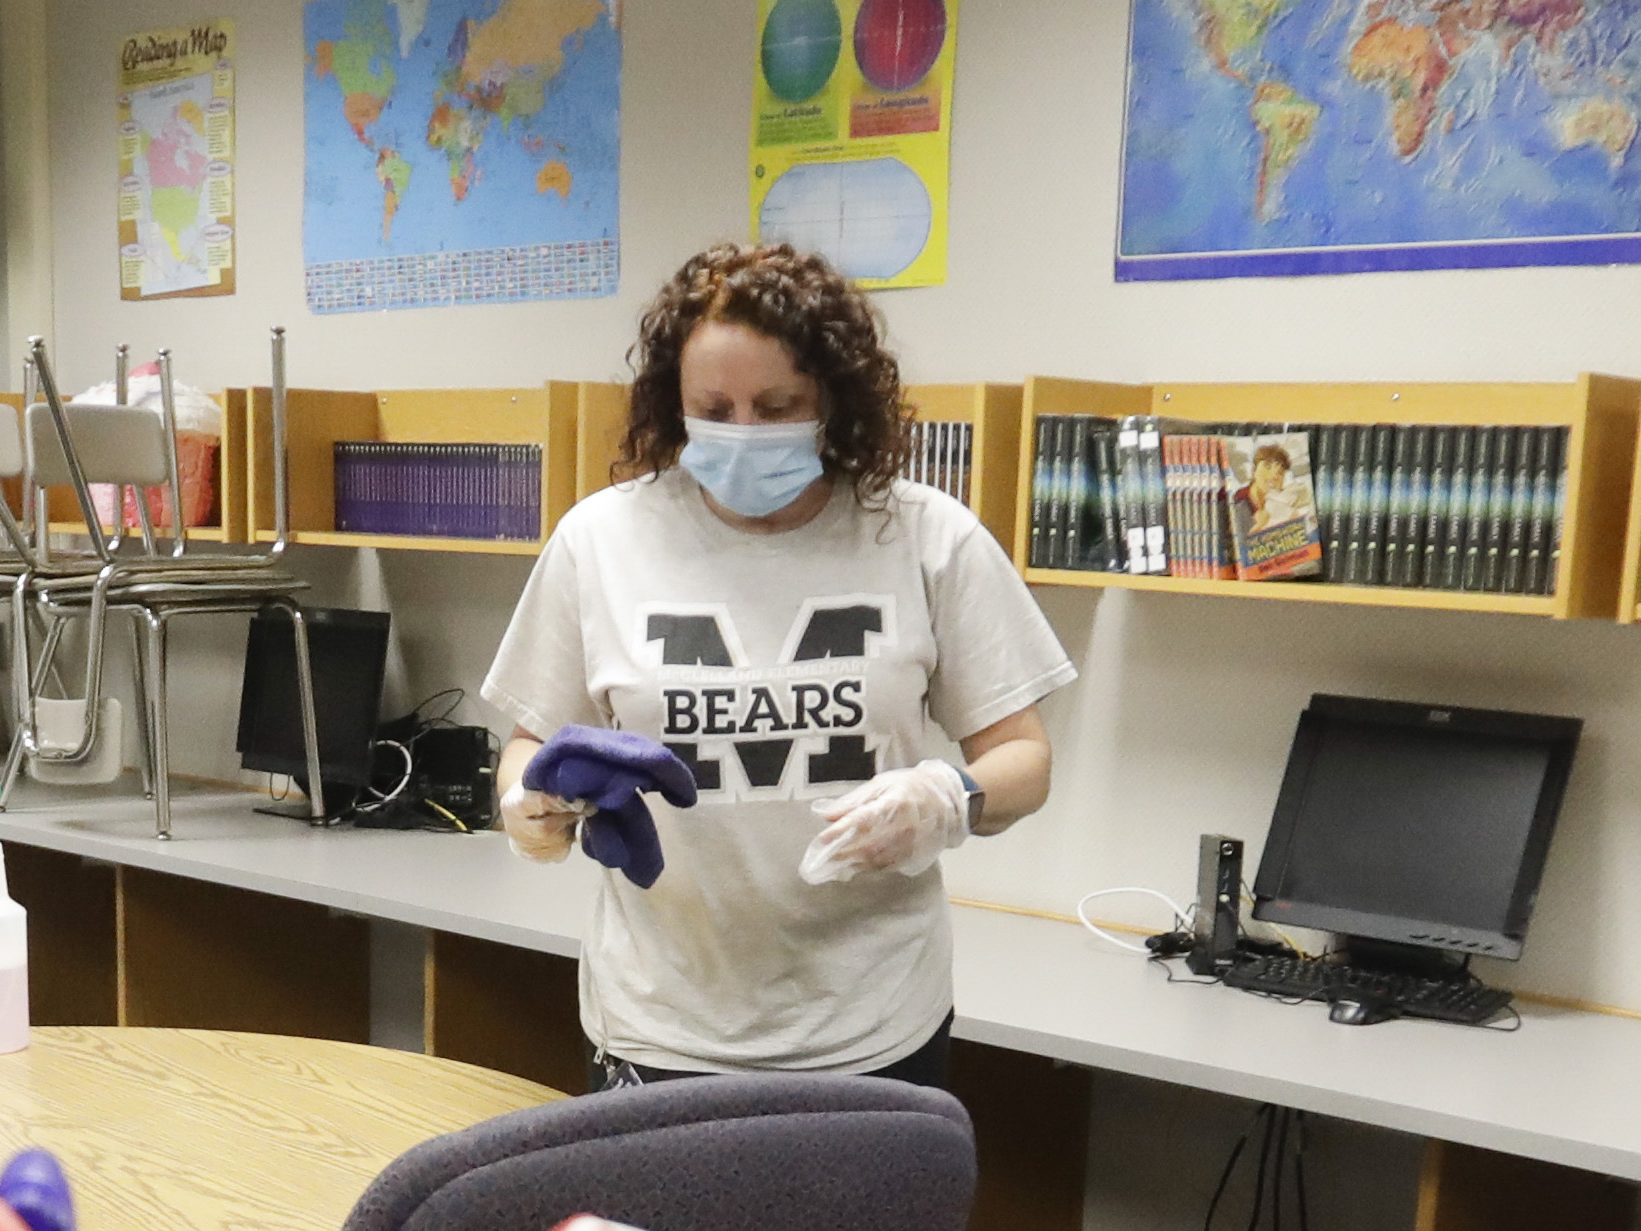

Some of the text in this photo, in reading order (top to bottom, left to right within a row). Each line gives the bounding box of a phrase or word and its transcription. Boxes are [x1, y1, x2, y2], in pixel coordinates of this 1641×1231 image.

[123, 36, 176, 70] Reading
[189, 26, 227, 59] Map
[1248, 528, 1310, 563] MACHINE
[769, 659, 870, 681] ELEMENTARY
[663, 680, 863, 734] BEARS
